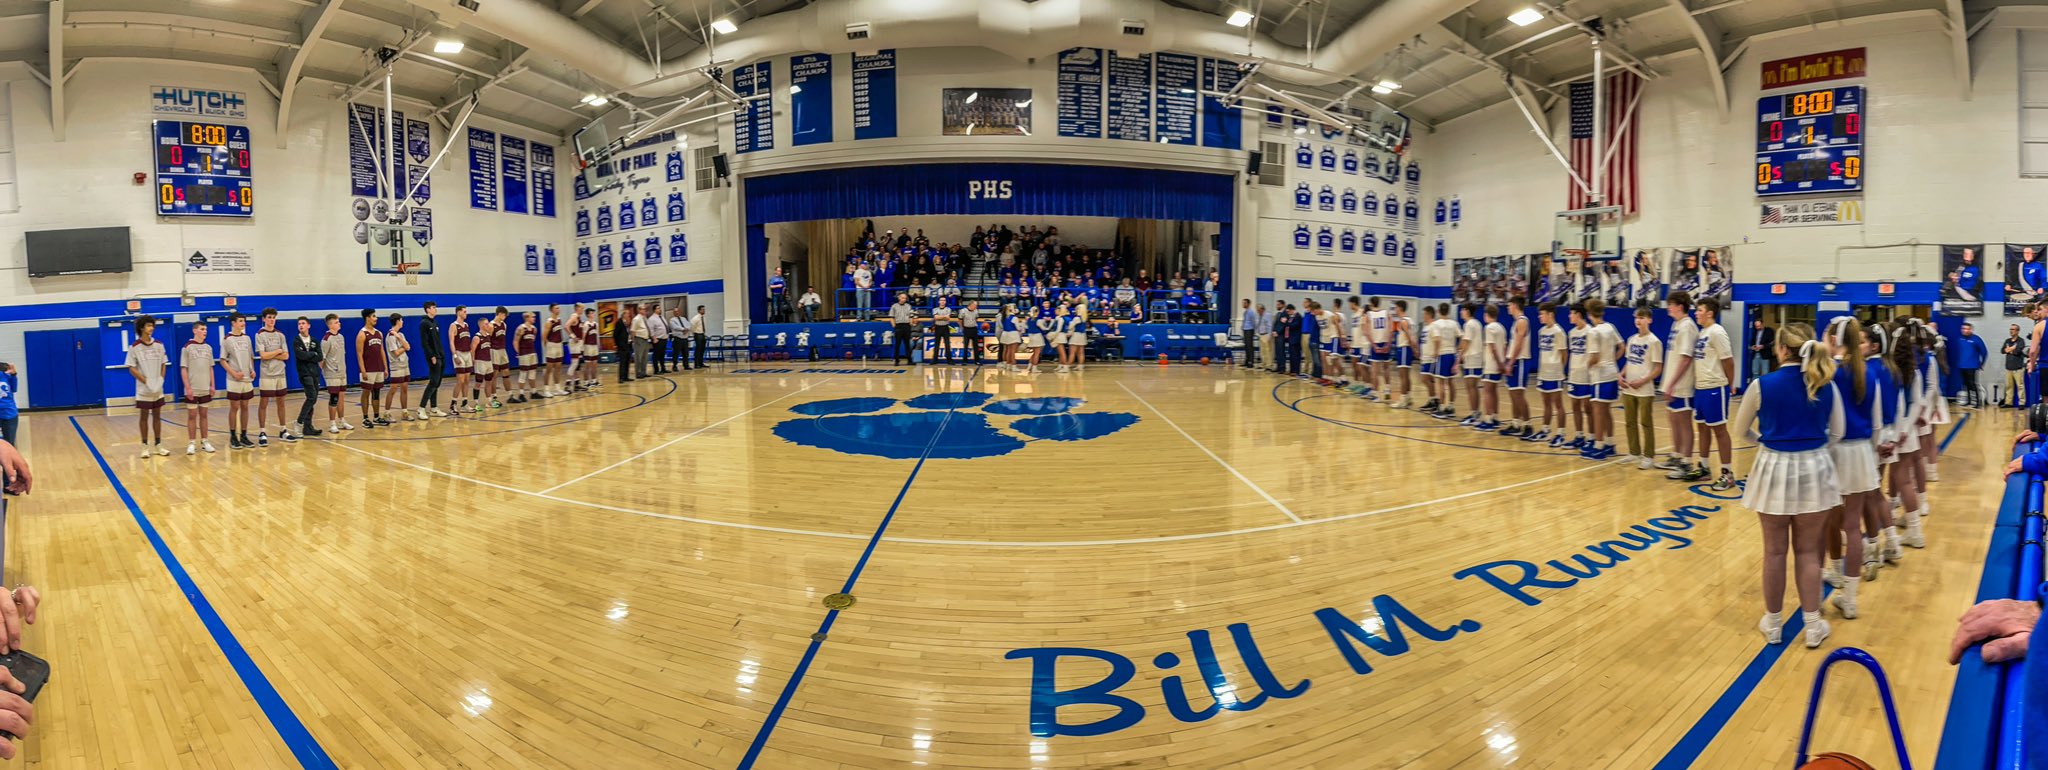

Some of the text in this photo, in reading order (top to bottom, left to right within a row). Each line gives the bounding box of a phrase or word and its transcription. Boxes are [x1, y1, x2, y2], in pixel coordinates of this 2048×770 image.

[793, 60, 829, 71] DISTRICT
[795, 67, 827, 77] CHAMPS
[857, 60, 891, 69] CHAMPS
[1780, 63, 1798, 83] i'm
[1834, 55, 1846, 75] it
[735, 70, 769, 82] DISTRCT
[737, 77, 768, 88] CHAPS
[153, 88, 244, 114] HUTCH
[154, 105, 196, 113] CHEVROLET
[1793, 91, 1833, 116] 8:00
[1770, 121, 1783, 142] 0
[1845, 113, 1860, 135] 0
[191, 124, 226, 145] 8:00
[229, 141, 247, 150] GUEST
[171, 146, 183, 165] 0
[239, 150, 249, 168] 0
[620, 157, 631, 172] OF
[634, 152, 657, 170] FAME
[1758, 163, 1771, 184] 0
[1845, 157, 1860, 178] 0
[162, 184, 174, 204] 0
[241, 187, 252, 206] 0
[968, 180, 1013, 199] PHS
[1783, 214, 1838, 223] FOR SERVING
[1004, 622, 1311, 738] Bill
[1313, 594, 1482, 675] M.
[1453, 503, 1722, 606] Runyon
